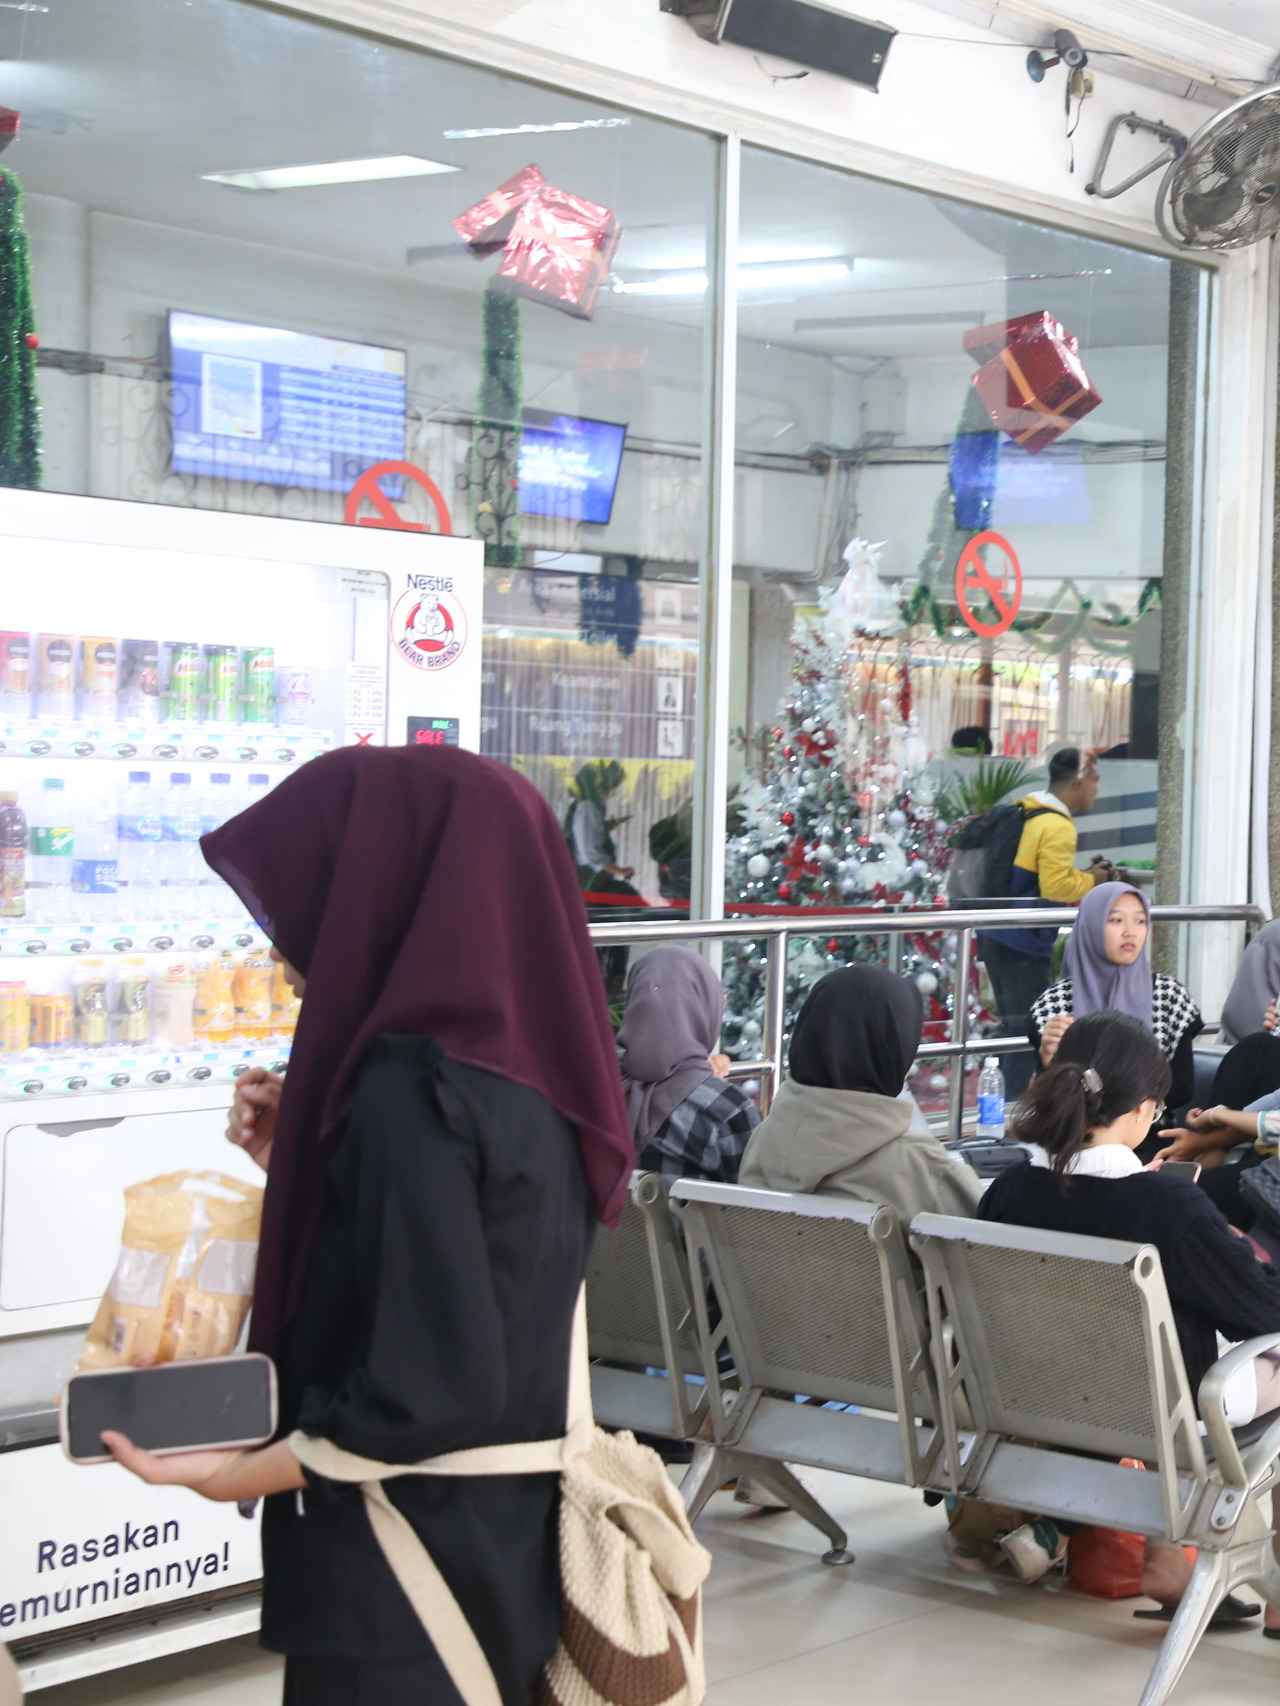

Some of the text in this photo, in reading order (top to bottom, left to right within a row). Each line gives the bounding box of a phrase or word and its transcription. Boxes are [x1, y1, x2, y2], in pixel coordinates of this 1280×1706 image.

[427, 641, 462, 668] BRAND
[529, 715, 622, 738] Ruang Tunggu
[36, 1519, 180, 1573] Rasakan
